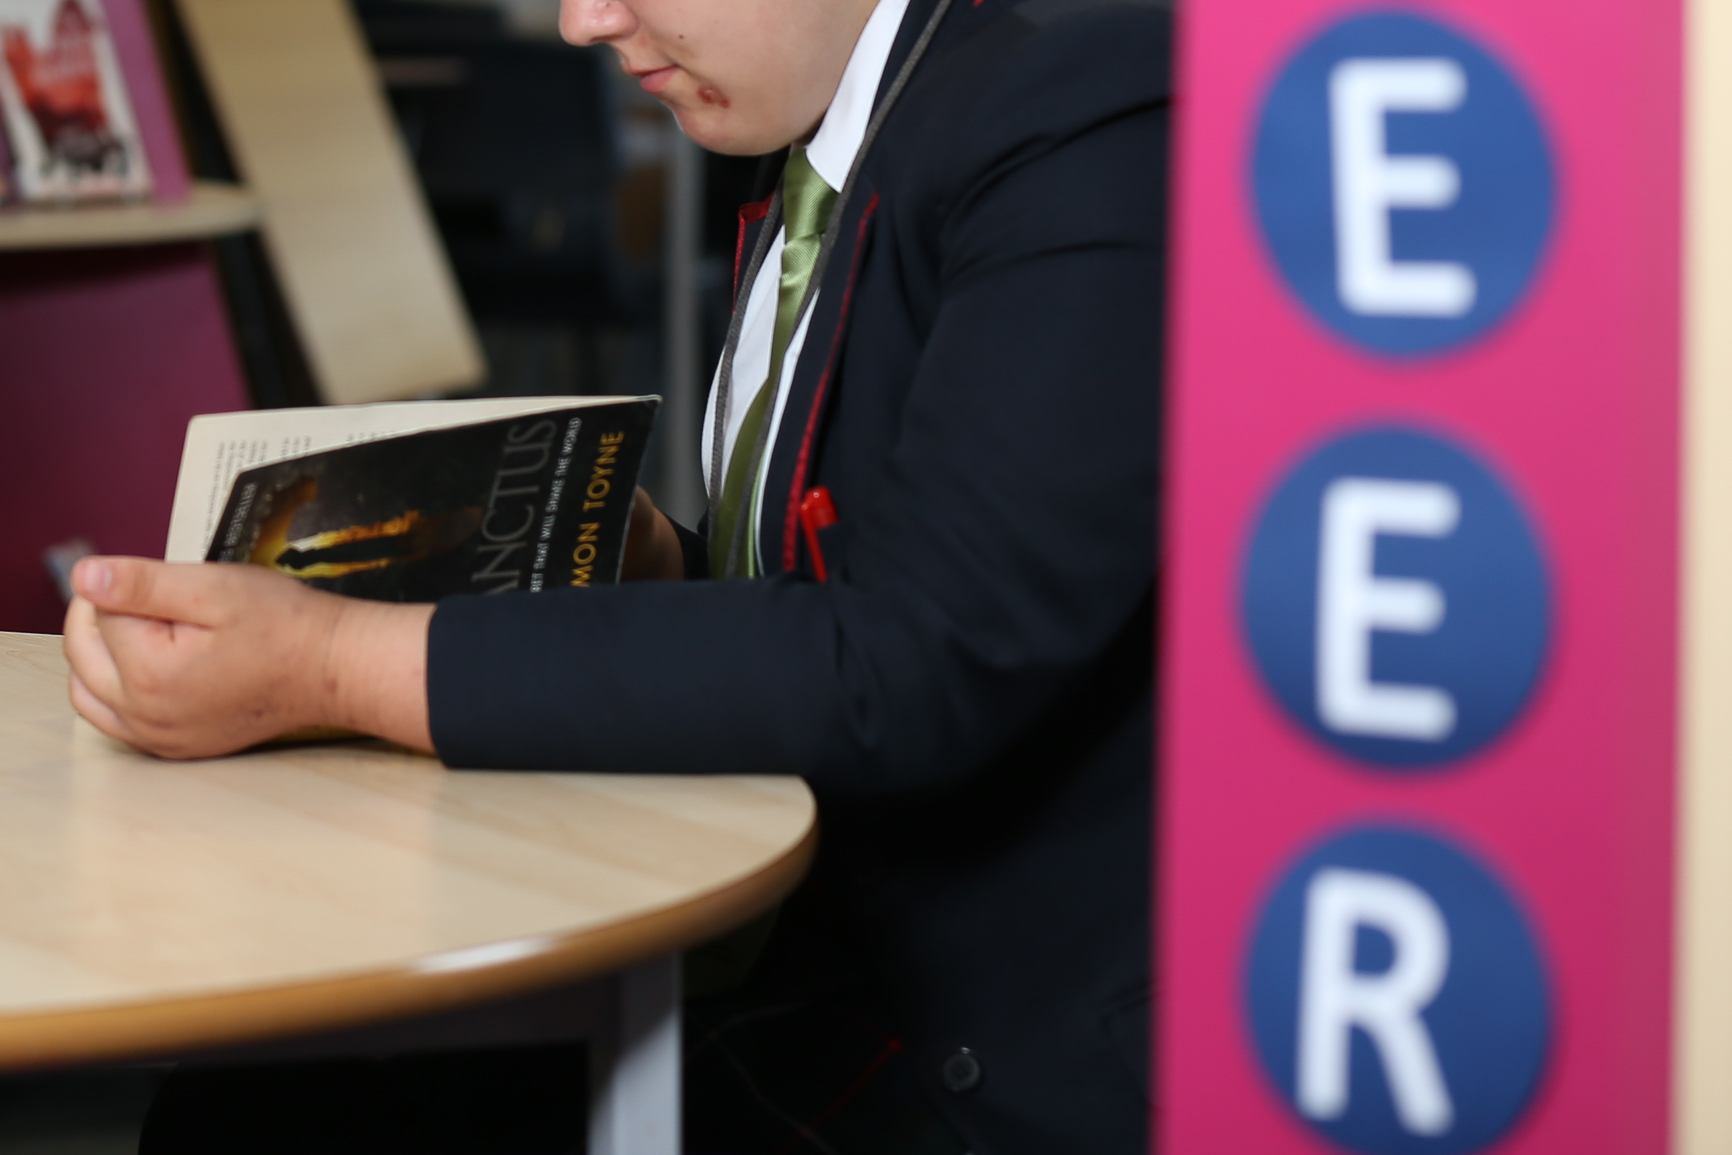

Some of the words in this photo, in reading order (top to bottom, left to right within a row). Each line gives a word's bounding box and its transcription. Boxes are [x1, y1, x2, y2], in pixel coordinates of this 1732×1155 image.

[561, 417, 582, 456] WORLD
[554, 457, 572, 478] THE
[582, 430, 625, 513] TOYNE
[545, 478, 566, 513] SHAKE
[539, 514, 556, 541] WILL
[533, 542, 550, 570] THAT
